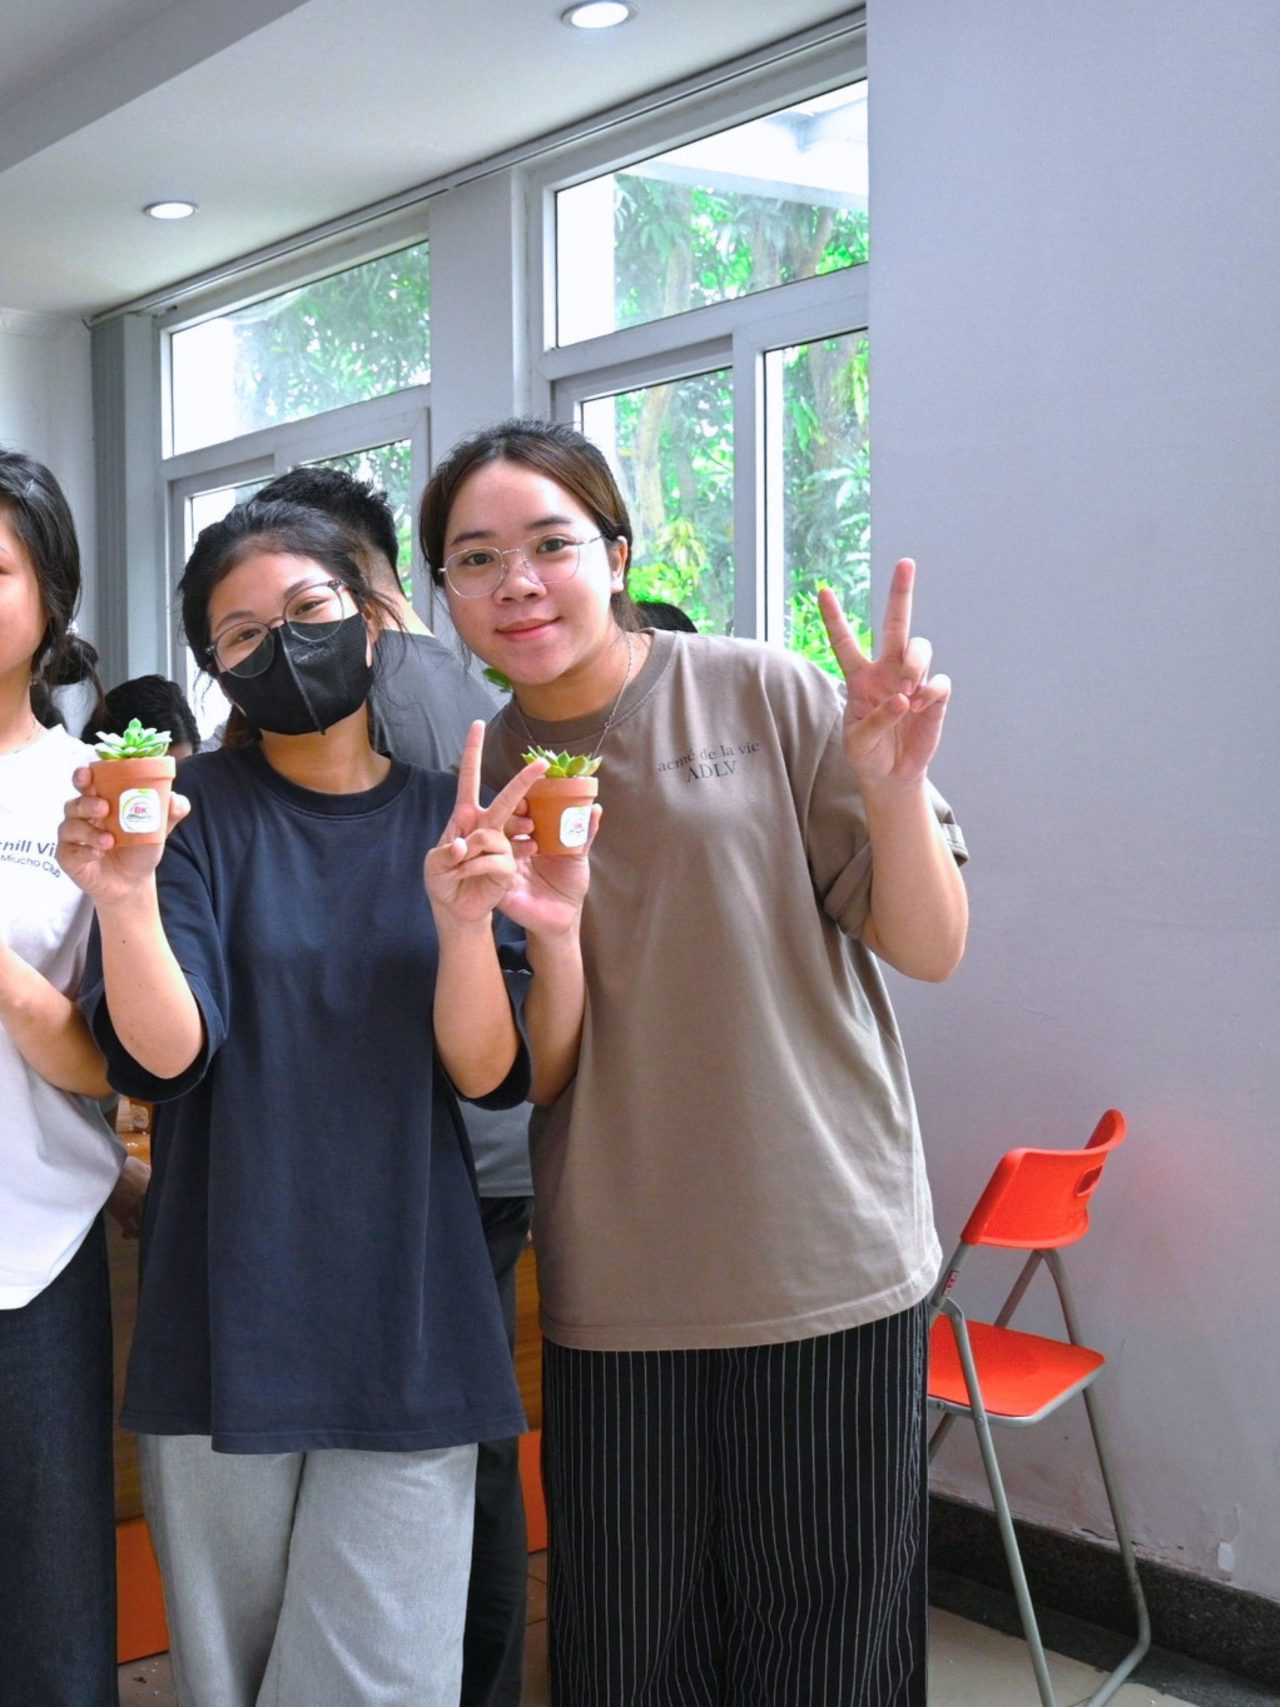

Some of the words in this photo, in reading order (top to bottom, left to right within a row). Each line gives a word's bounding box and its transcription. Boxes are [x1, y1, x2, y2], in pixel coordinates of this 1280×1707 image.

[738, 742, 760, 755] vie
[686, 760, 736, 783] ADLV
[37, 842, 57, 859] Vi
